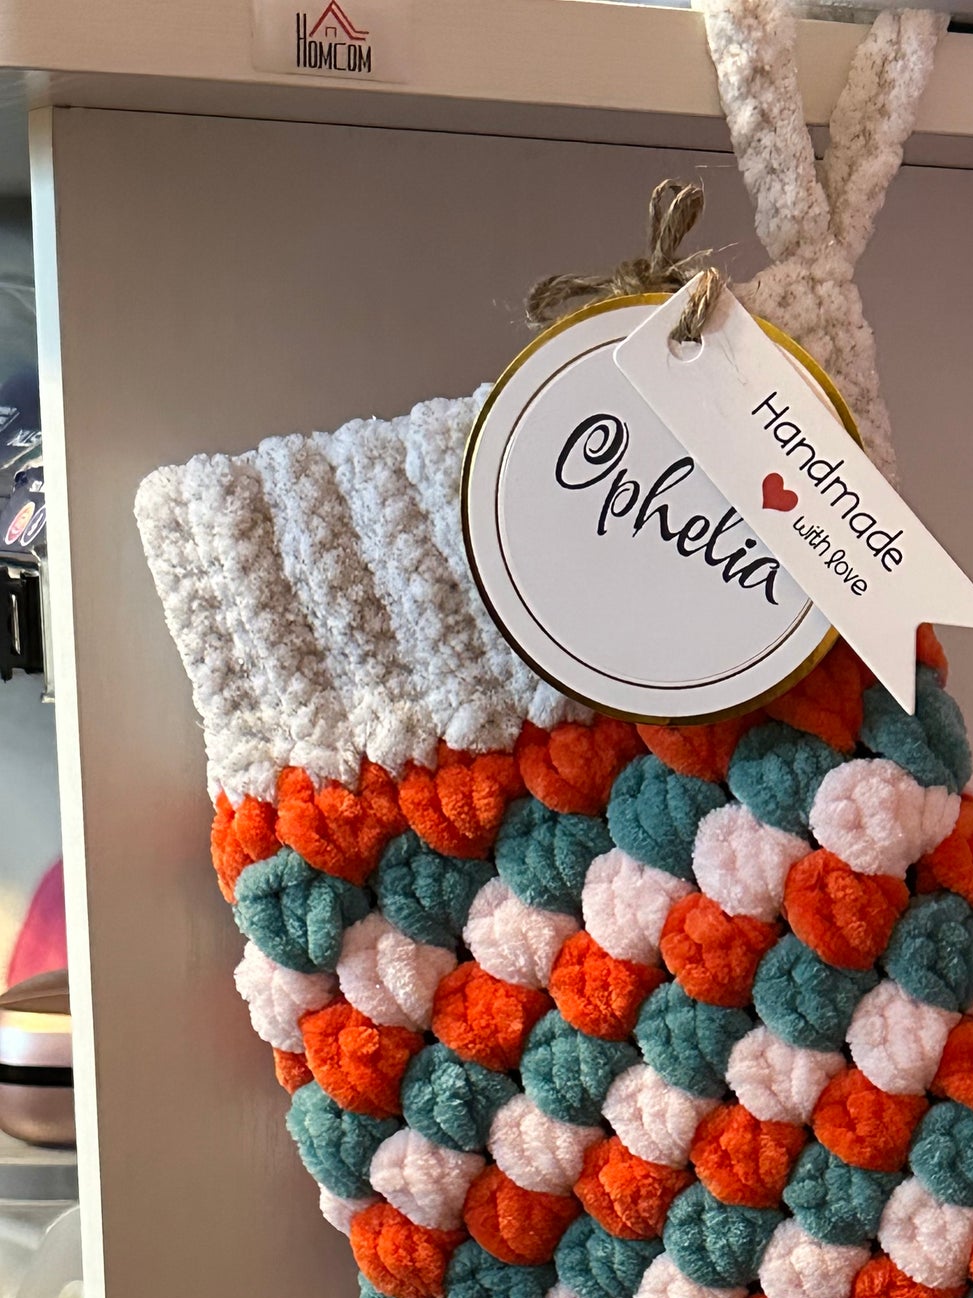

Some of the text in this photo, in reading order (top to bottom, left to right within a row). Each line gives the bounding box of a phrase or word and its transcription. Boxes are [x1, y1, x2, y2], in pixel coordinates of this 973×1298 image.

[555, 413, 780, 605] Ophelia
[751, 391, 904, 572] Handmade
[792, 516, 868, 596] with love
